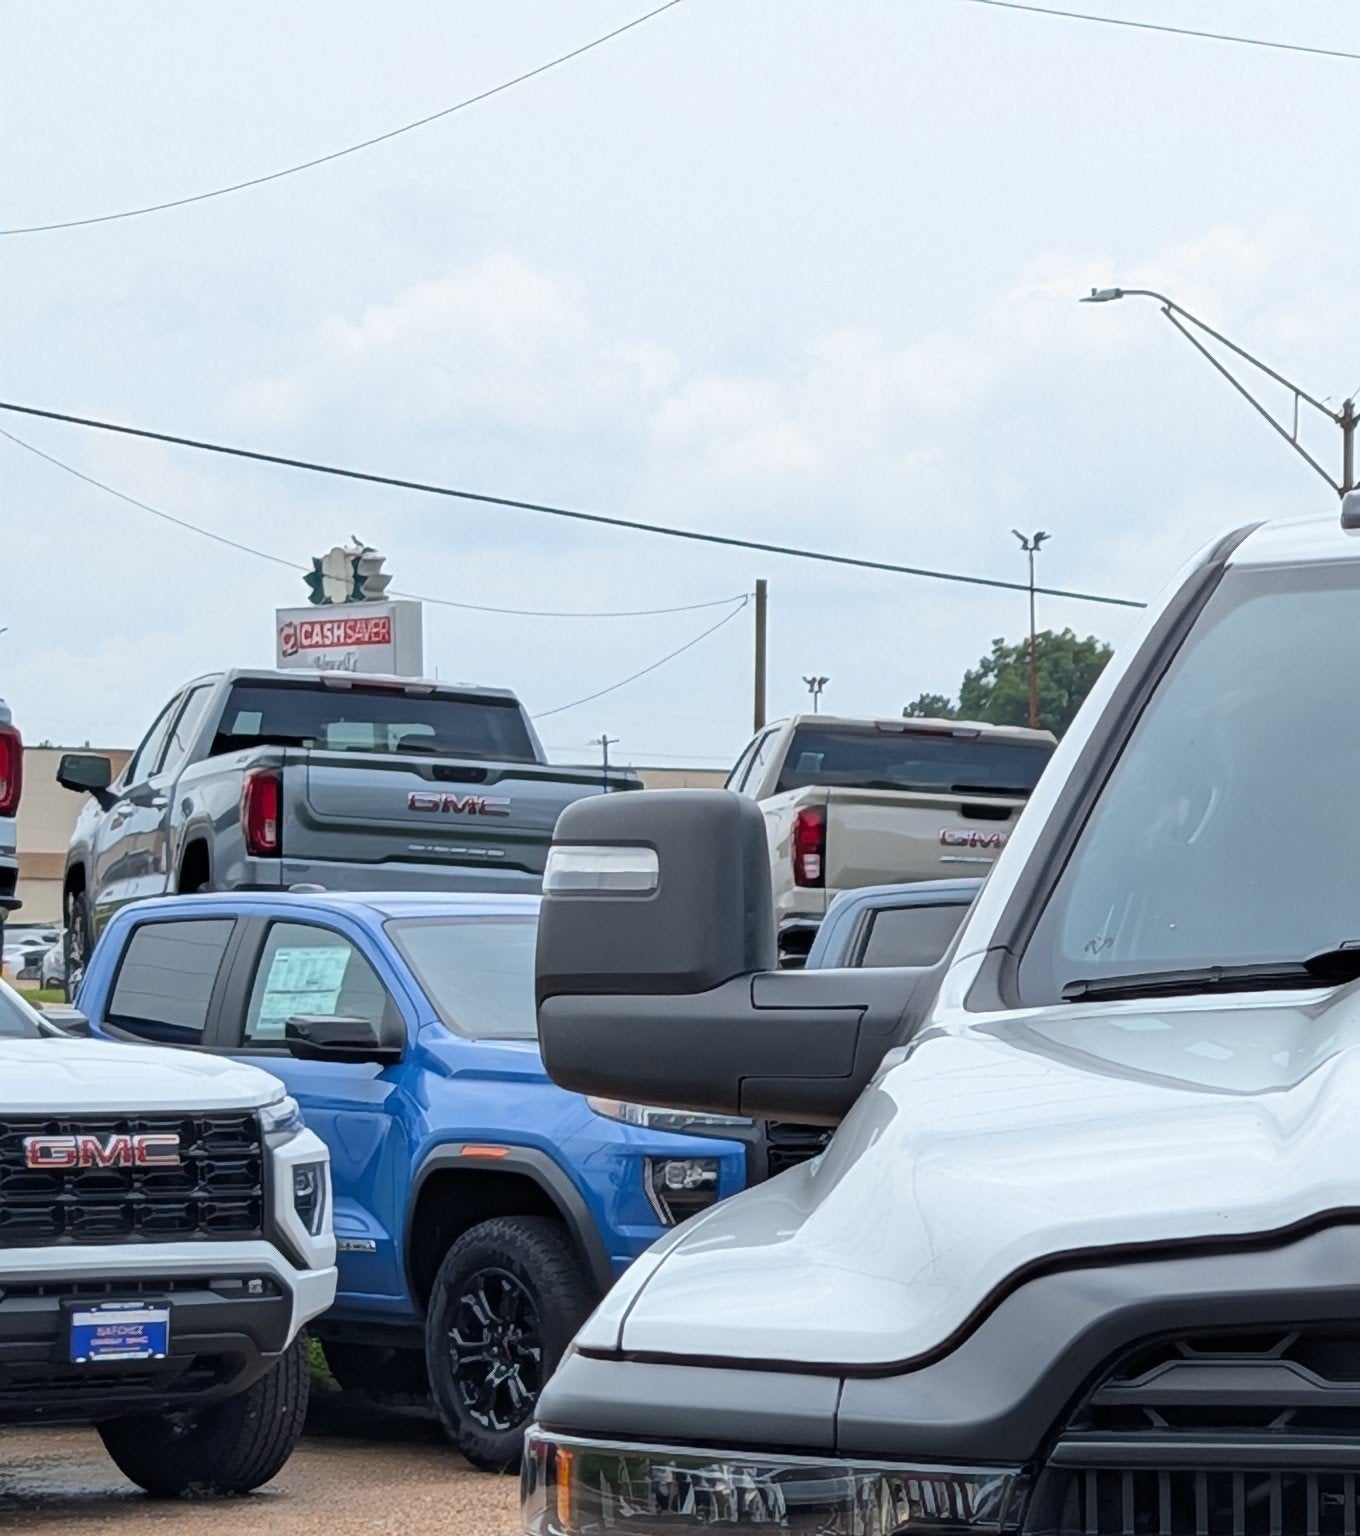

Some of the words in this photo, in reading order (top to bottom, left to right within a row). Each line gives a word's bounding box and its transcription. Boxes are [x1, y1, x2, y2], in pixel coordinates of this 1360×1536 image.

[408, 791, 511, 817] GMC
[939, 828, 1007, 849] GM
[23, 1134, 181, 1169] GMC
